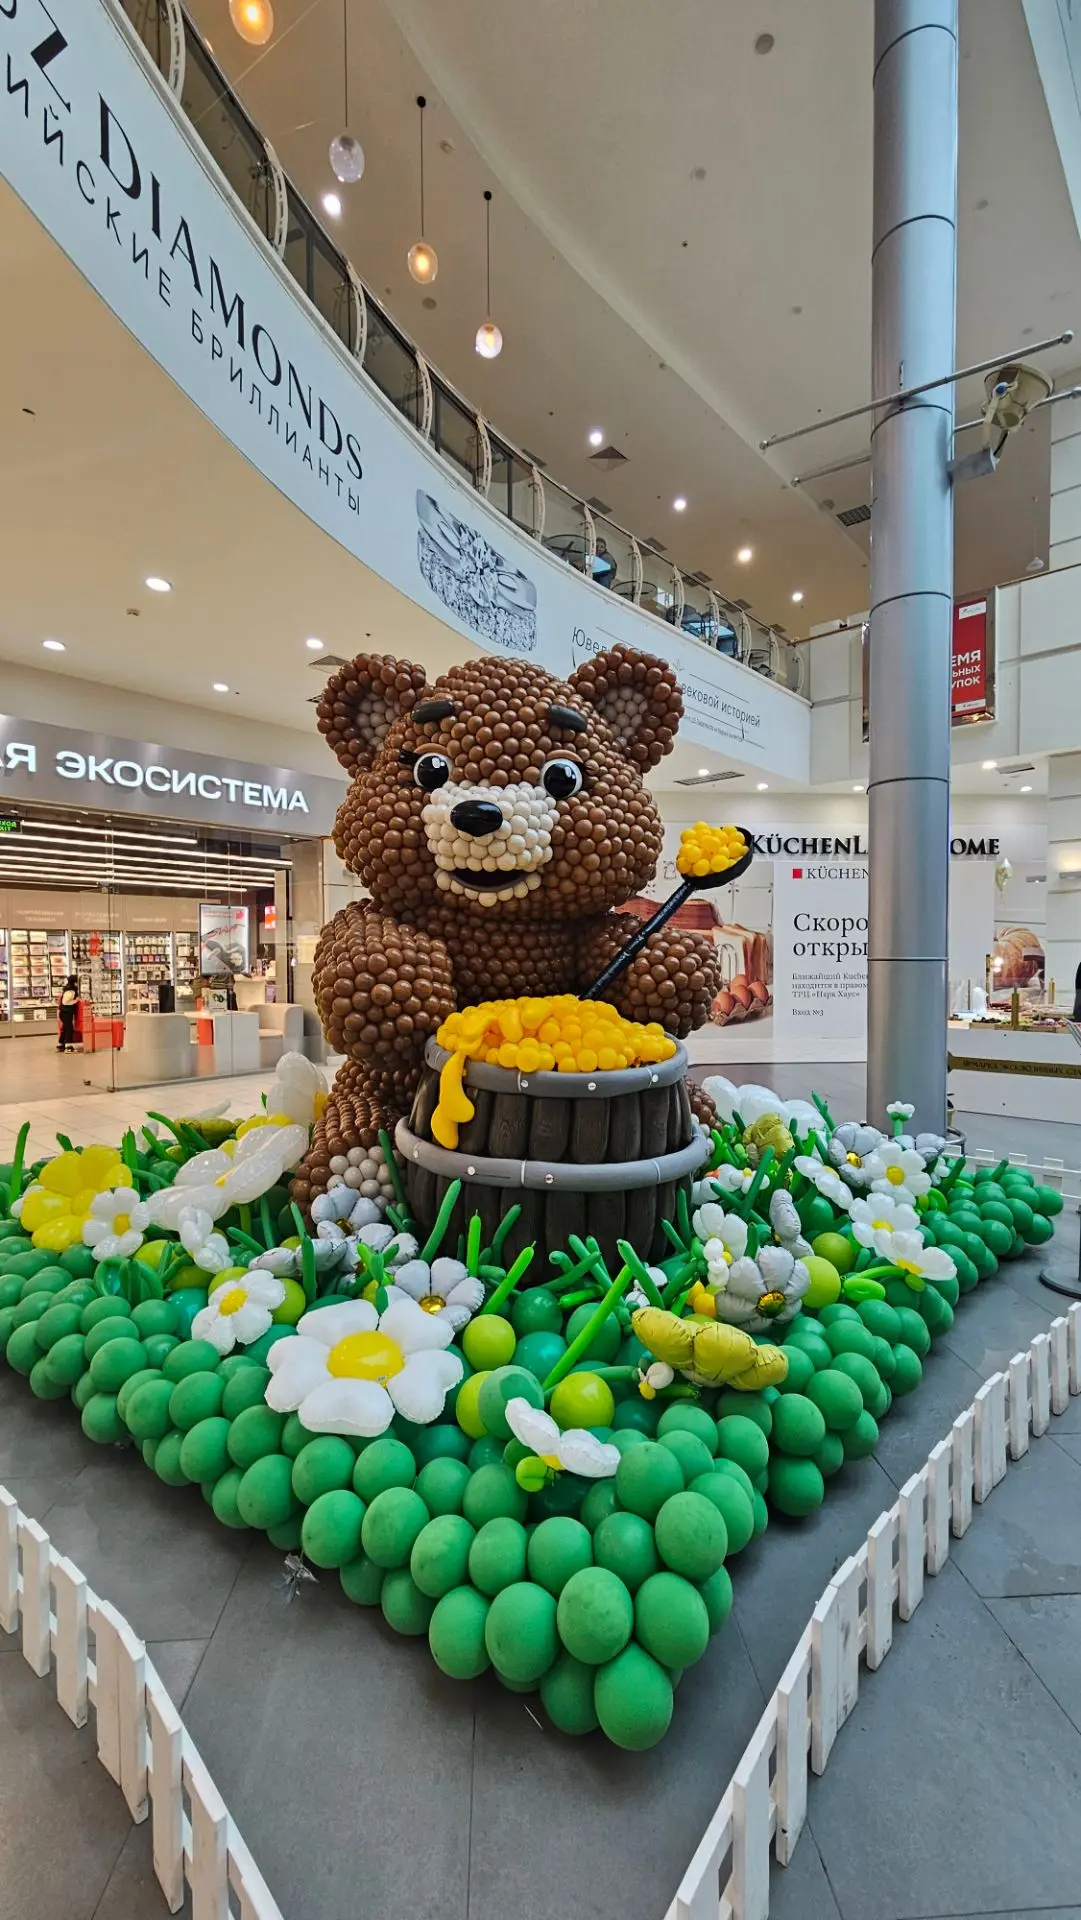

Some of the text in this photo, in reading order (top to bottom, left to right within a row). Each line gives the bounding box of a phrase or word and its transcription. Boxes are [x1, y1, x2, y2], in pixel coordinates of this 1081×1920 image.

[98, 92, 363, 480] DIAMONDS
[191, 308, 360, 515] БРИЛЛИАНТЫ
[721, 702, 760, 727] историей
[56, 750, 309, 813] ЭКОСИСТЕМА
[793, 913, 868, 938] Скоро
[793, 942, 868, 963] откры
